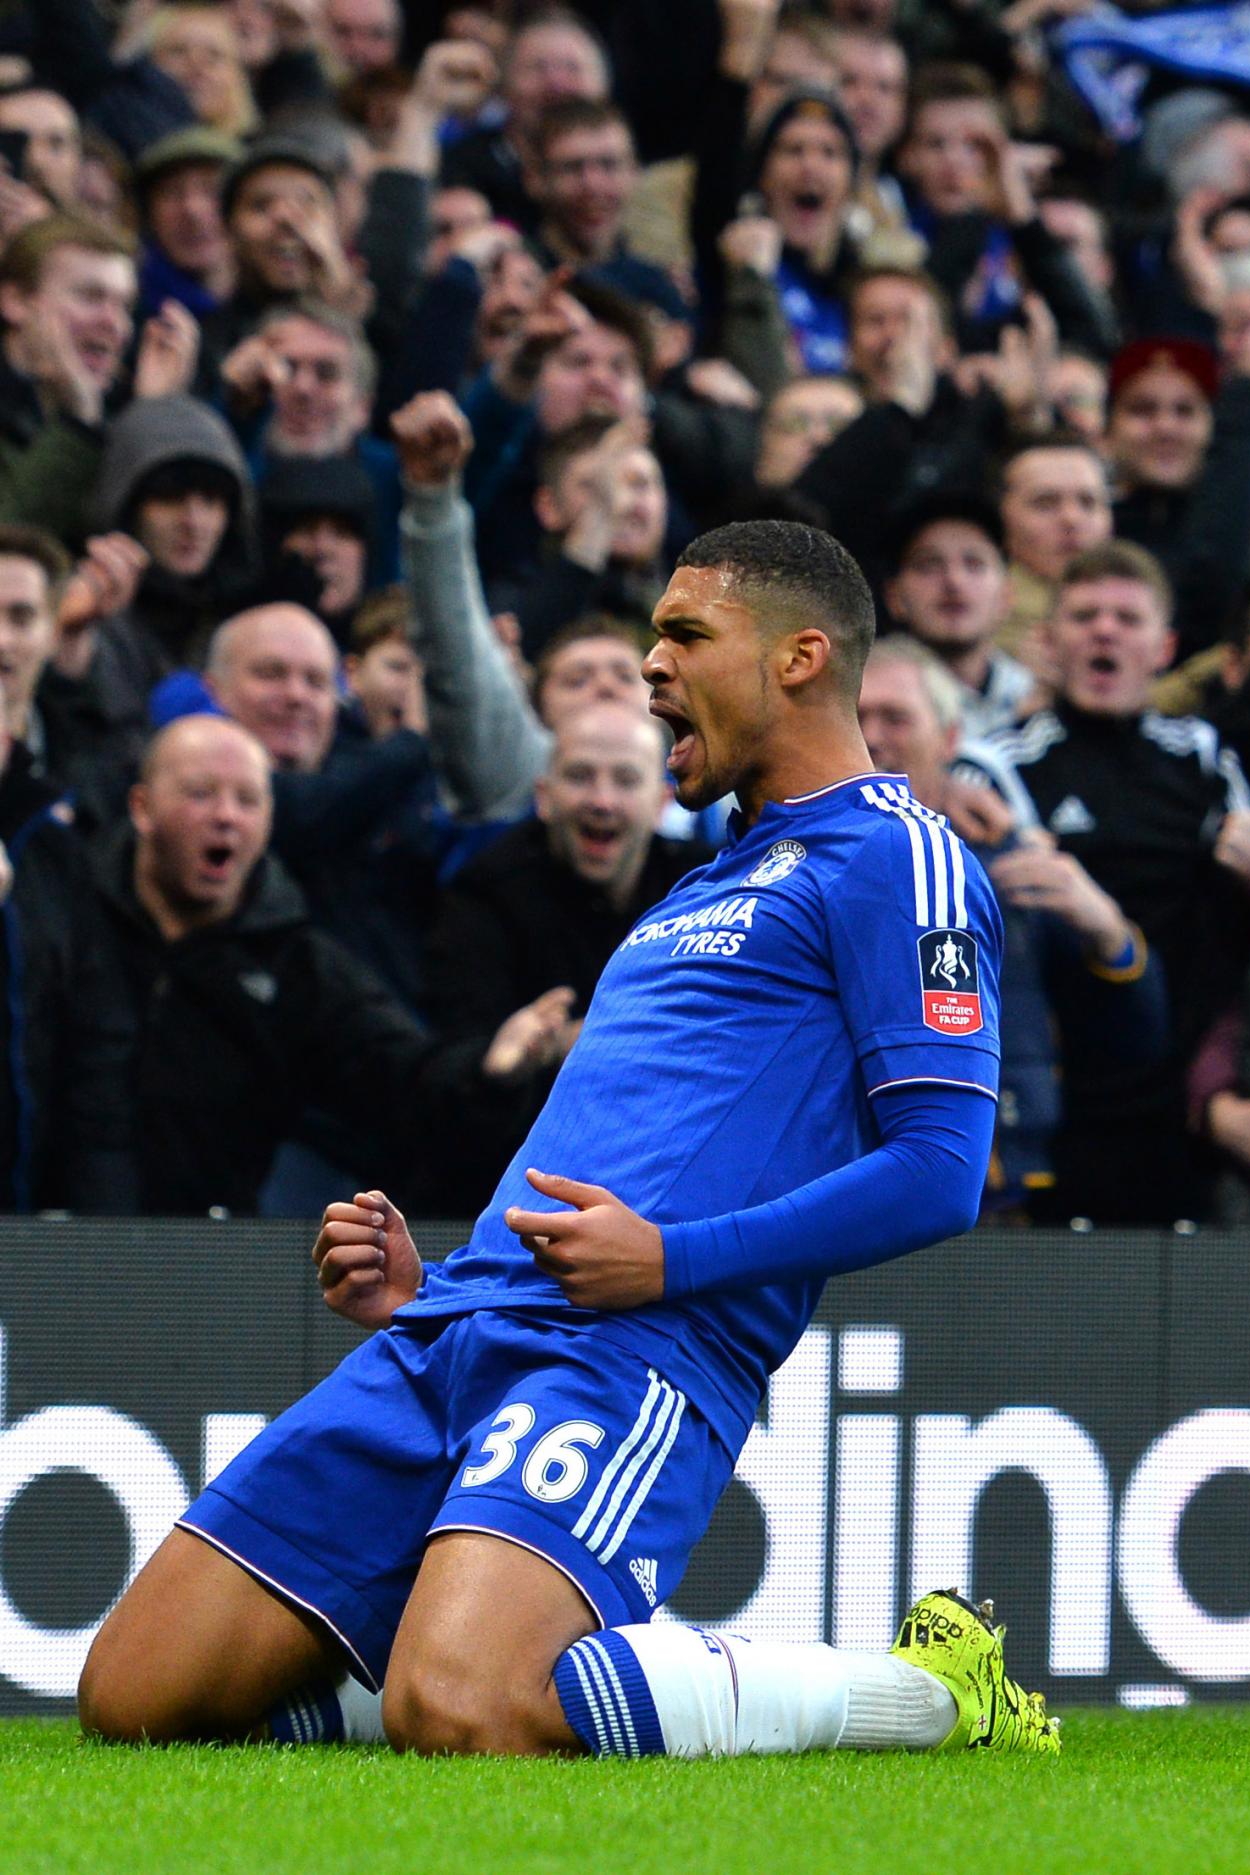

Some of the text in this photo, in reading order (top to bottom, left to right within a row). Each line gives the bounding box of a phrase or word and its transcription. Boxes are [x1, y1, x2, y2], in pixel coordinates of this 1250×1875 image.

[670, 931, 747, 957] TYRES
[931, 1003, 975, 1016] Emirates
[939, 1014, 970, 1025] FA CUP
[460, 1402, 606, 1504] 36
[628, 1559, 657, 1608] adidas
[910, 1606, 963, 1640] adida
